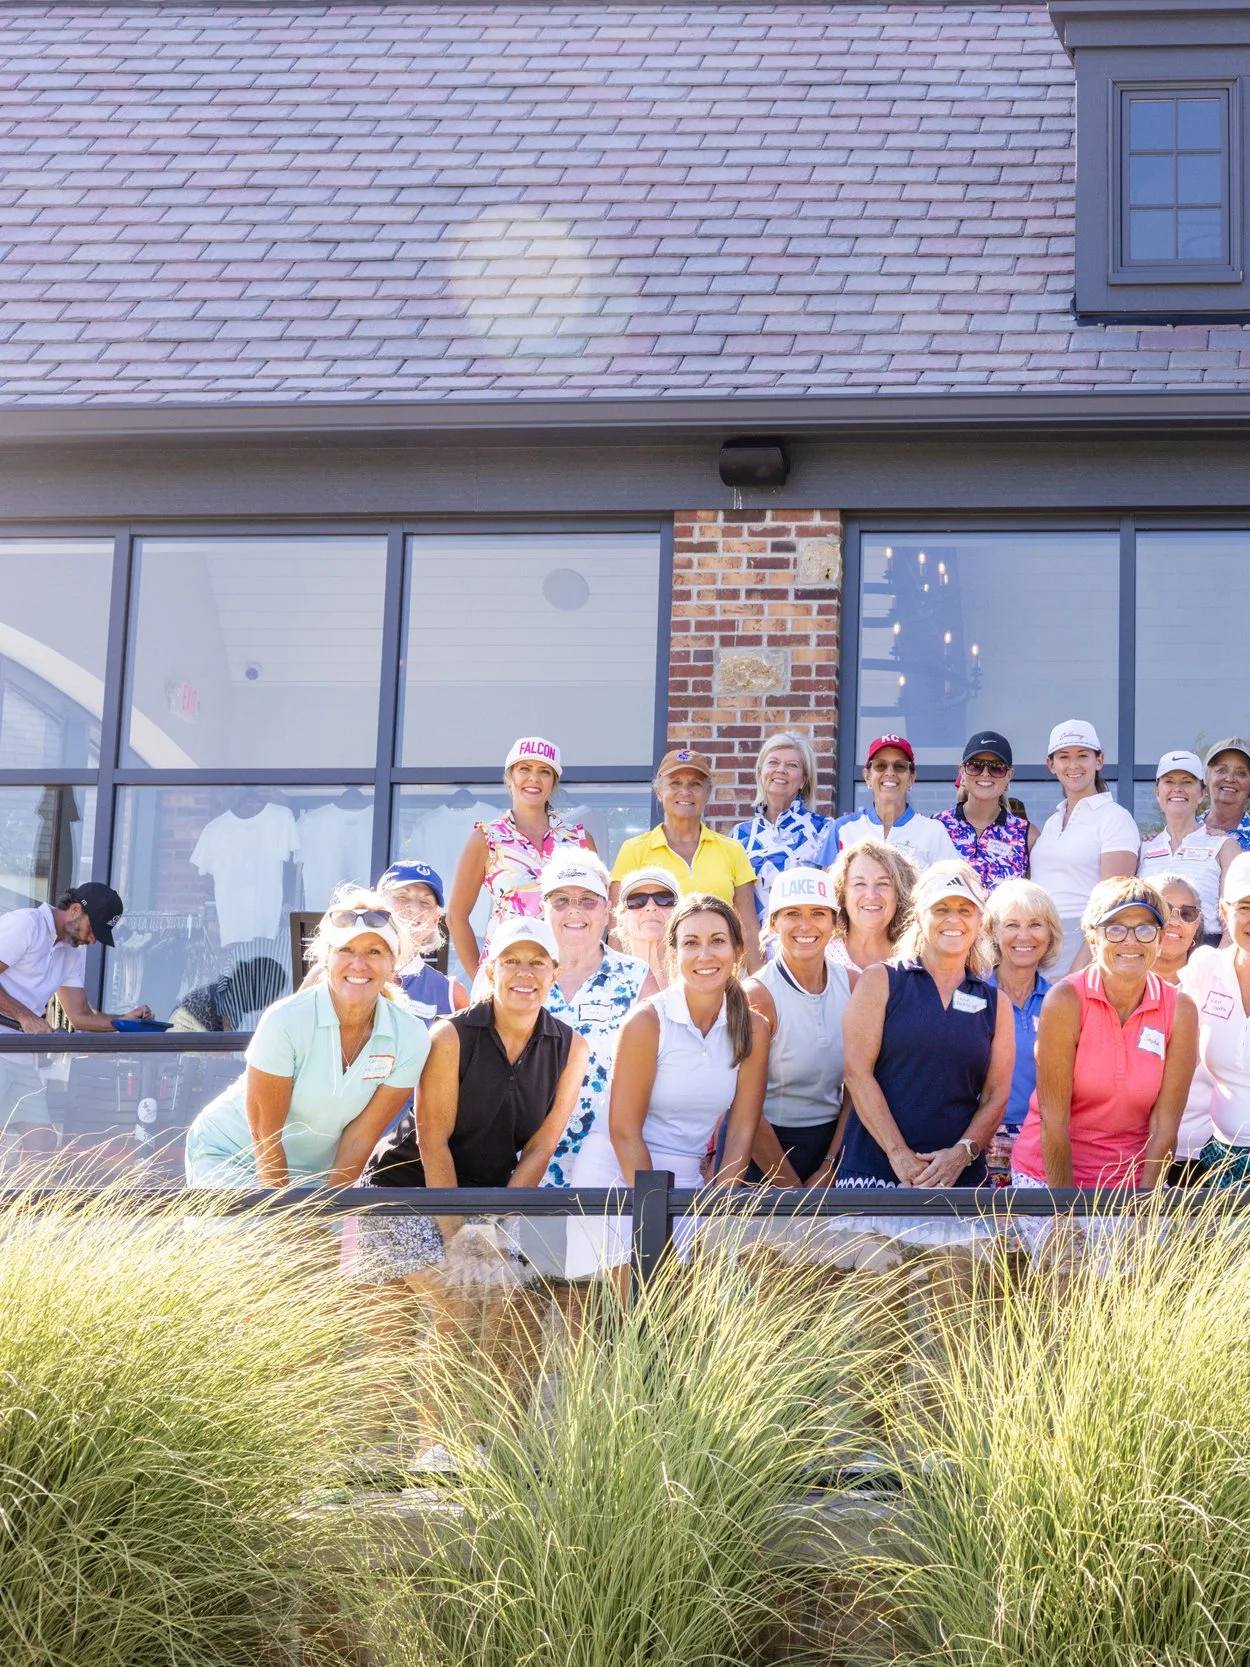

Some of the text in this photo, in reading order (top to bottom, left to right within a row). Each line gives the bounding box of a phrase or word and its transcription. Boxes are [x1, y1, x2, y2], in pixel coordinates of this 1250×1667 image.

[881, 733, 900, 743] KC
[519, 741, 556, 761] FALCON
[781, 879, 828, 898] LAKE Q
